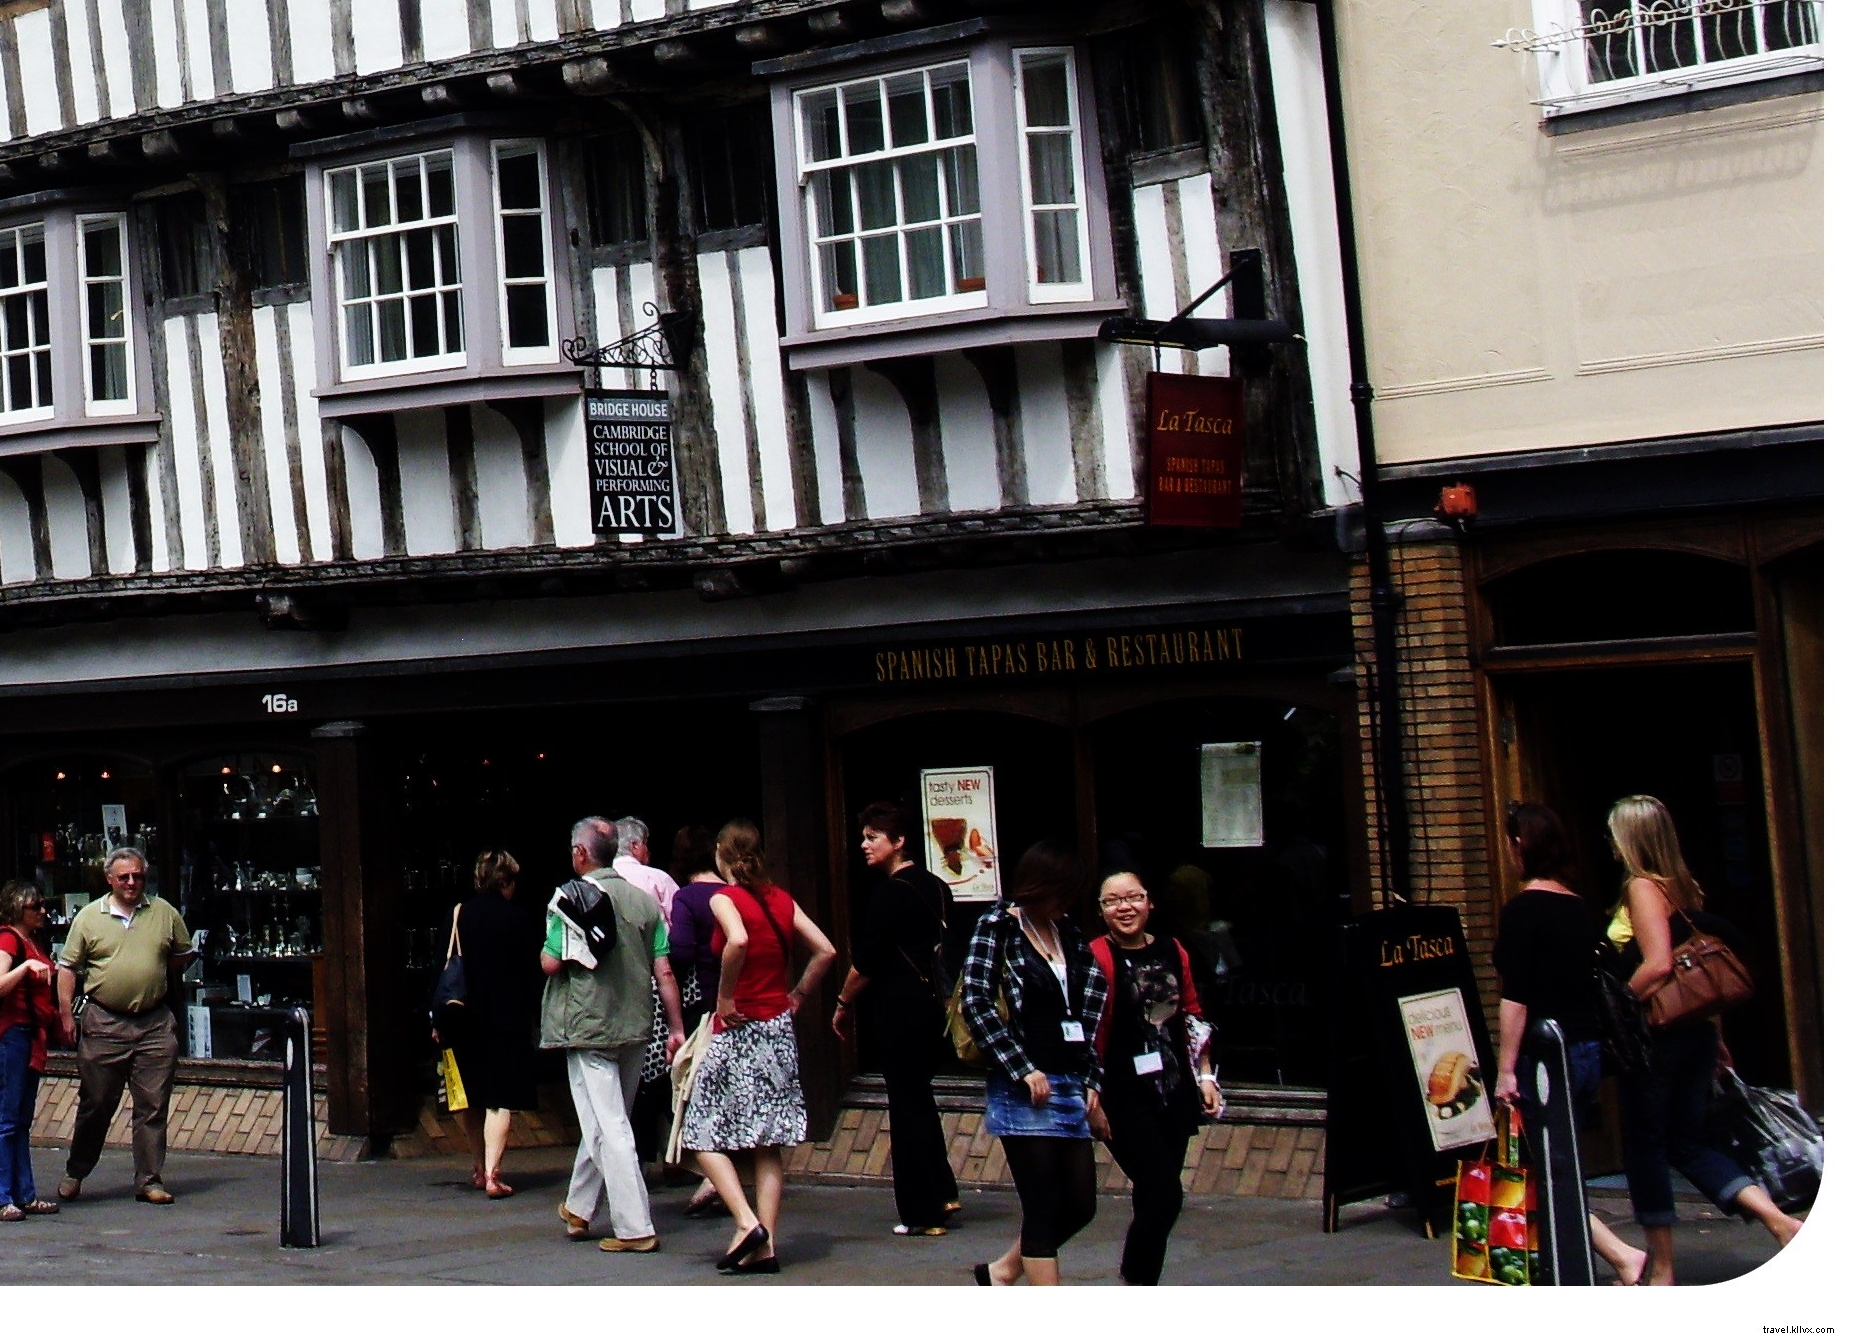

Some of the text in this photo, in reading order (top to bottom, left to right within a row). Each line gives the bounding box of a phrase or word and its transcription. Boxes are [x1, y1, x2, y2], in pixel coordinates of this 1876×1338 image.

[589, 402, 668, 417] BRIDGE HOUSE
[1156, 409, 1232, 434] La Tasca
[593, 425, 667, 440] CAMBRIDGE
[594, 442, 668, 456] SCHOOL OF
[595, 456, 668, 477] VISUAL &
[596, 478, 670, 492] PERFORMING
[597, 495, 673, 528] ARTS
[875, 627, 1245, 682] SPANISH TAPAS BAR & RESTAURANT
[261, 693, 298, 713] 16a
[929, 779, 981, 794] tasty NEW
[930, 794, 973, 806] desserts
[1380, 934, 1454, 966] La Tasca
[1222, 973, 1308, 1006] Tasca
[1411, 1023, 1434, 1040] NEW
